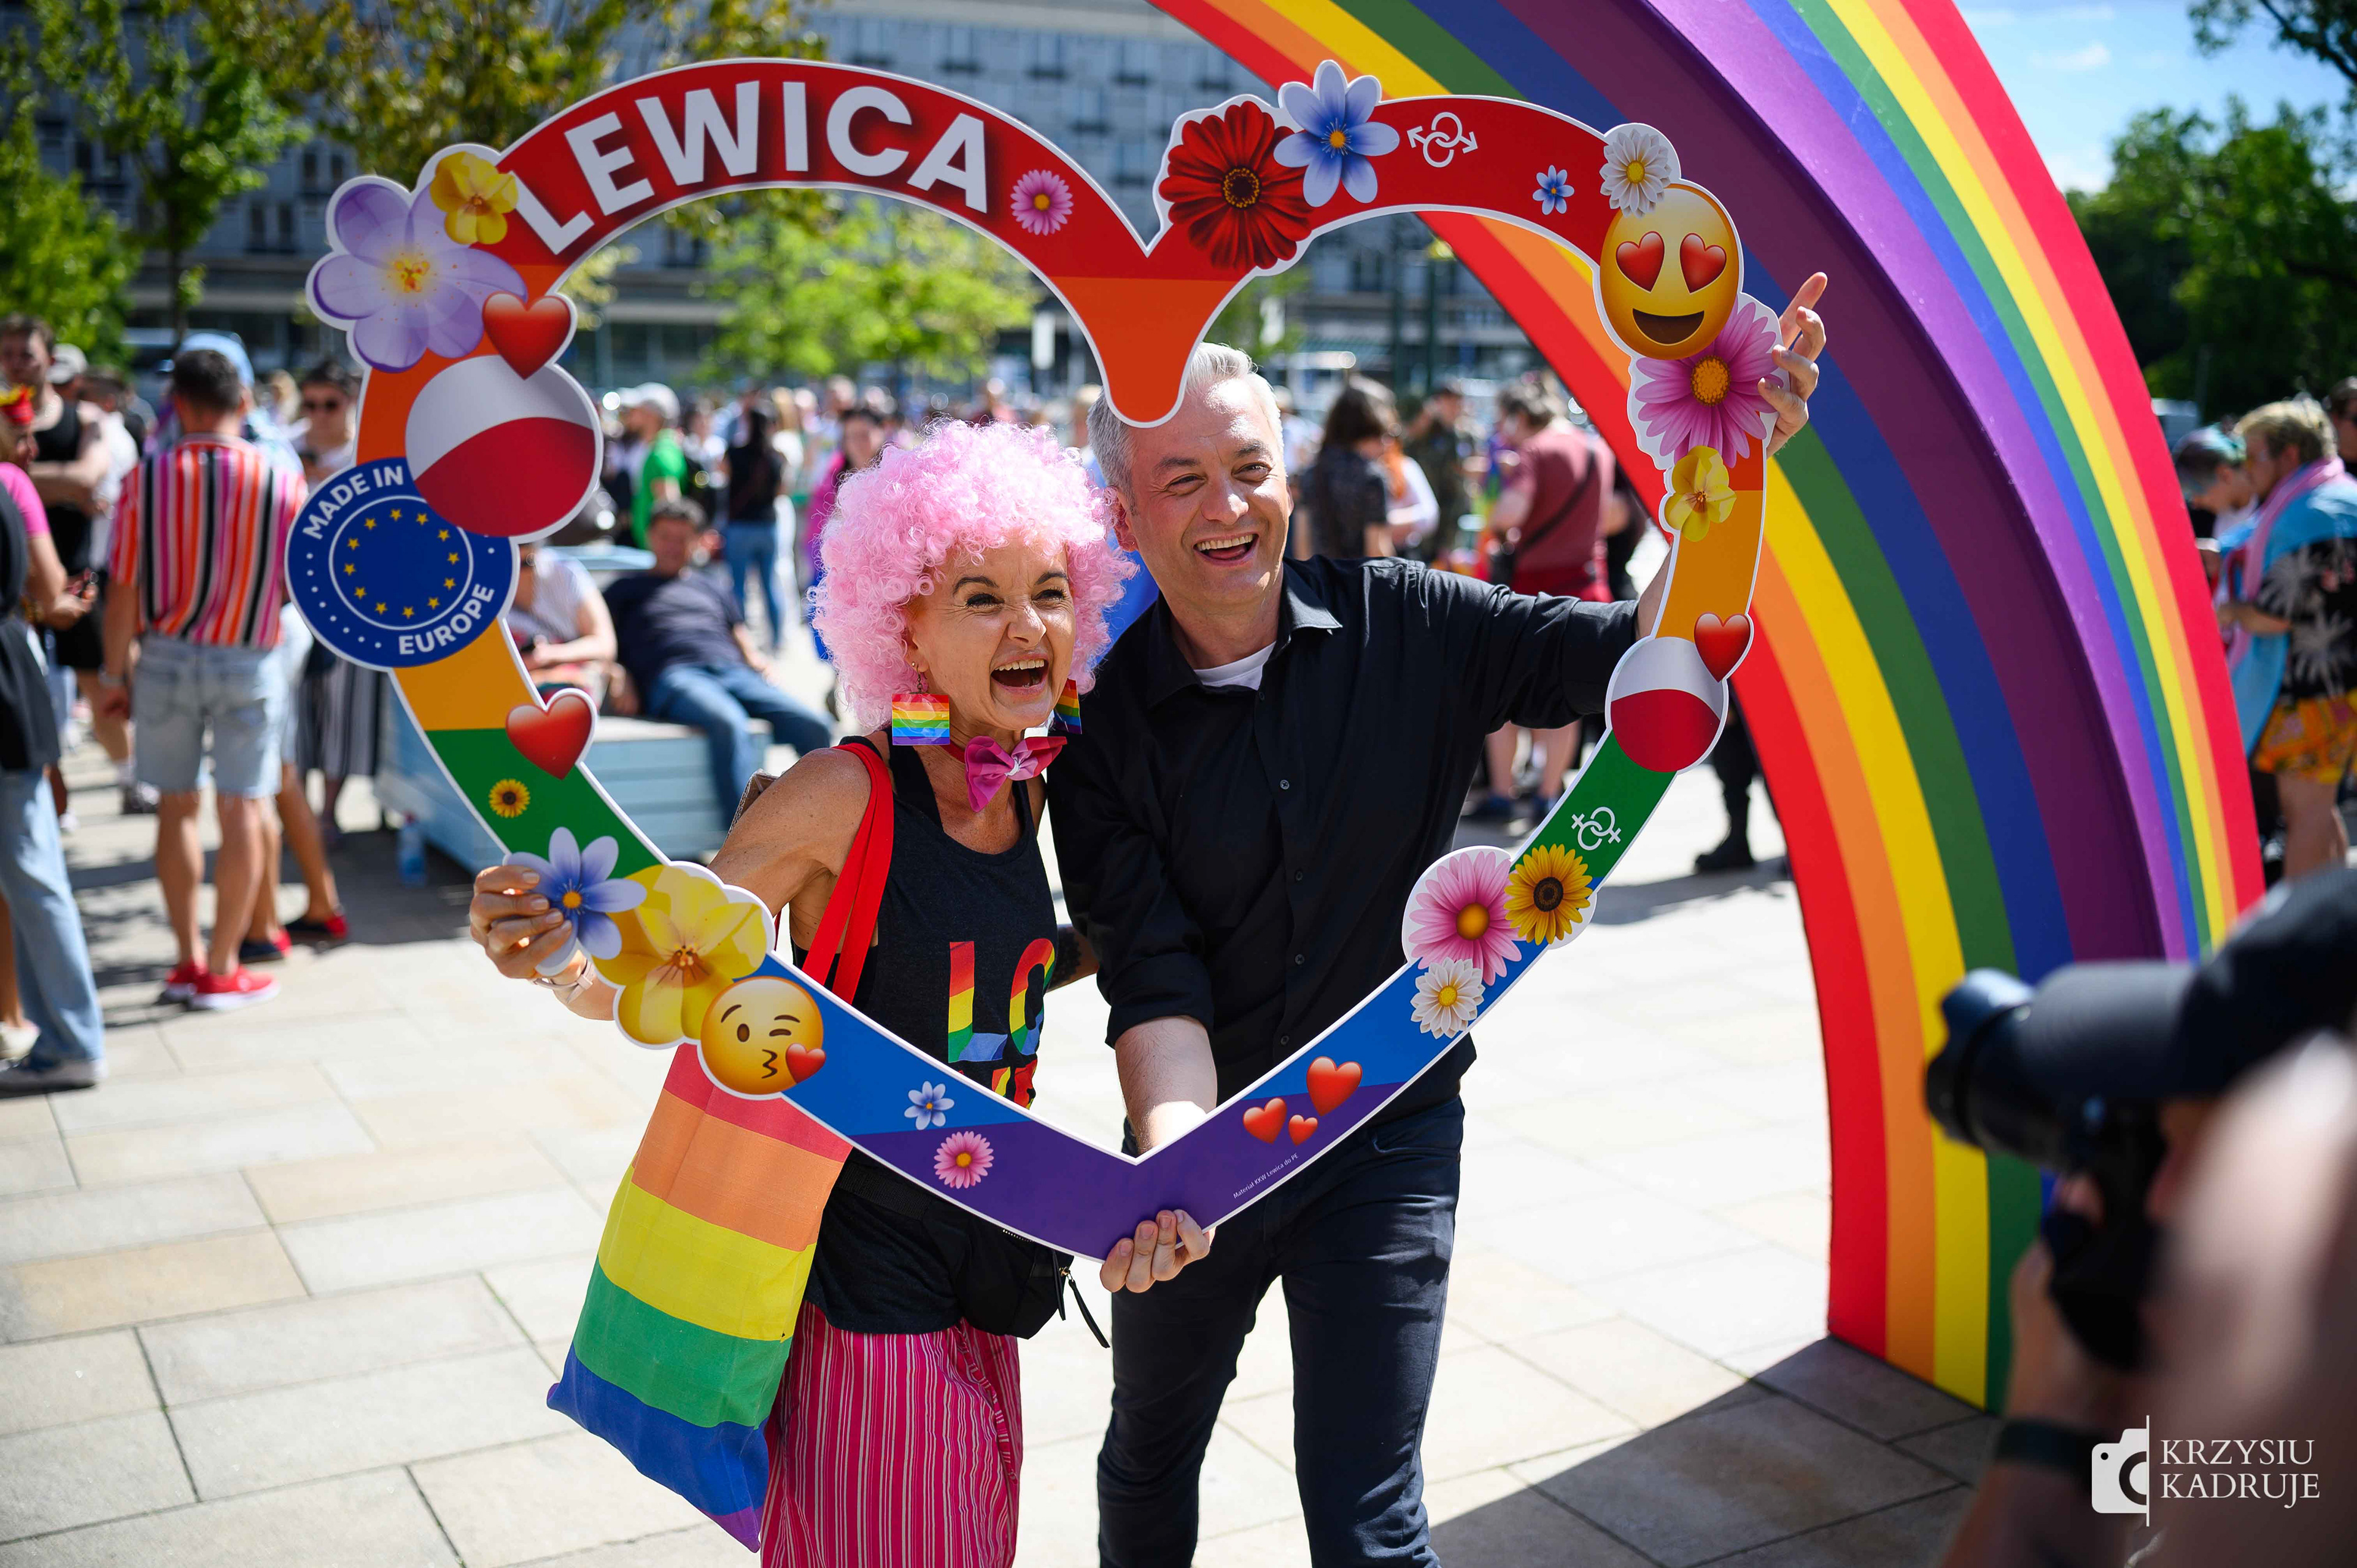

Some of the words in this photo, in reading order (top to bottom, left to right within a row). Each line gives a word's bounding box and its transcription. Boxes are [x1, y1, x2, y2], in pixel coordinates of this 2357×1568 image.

[508, 80, 987, 255] LEWICA
[303, 473, 370, 539] MADE
[373, 466, 404, 488] IN
[398, 584, 494, 655] EUROPE
[1233, 1181, 1255, 1199] Material
[1254, 1173, 1266, 1185] KKW
[1266, 1165, 1284, 1177] Lewica
[1291, 1153, 1299, 1161] PE
